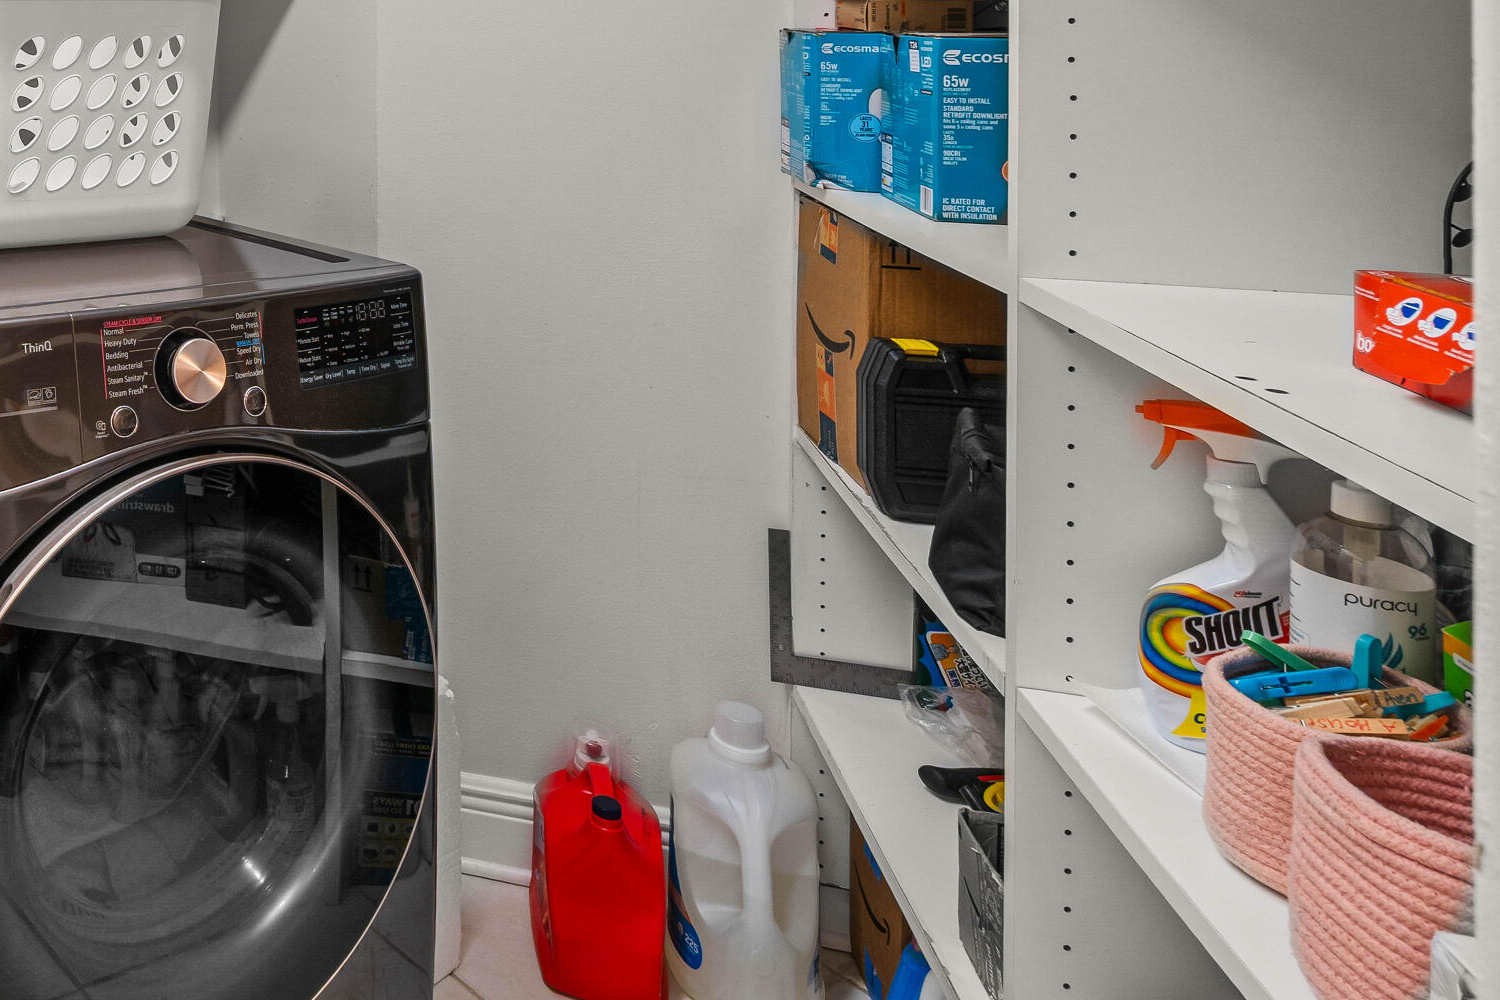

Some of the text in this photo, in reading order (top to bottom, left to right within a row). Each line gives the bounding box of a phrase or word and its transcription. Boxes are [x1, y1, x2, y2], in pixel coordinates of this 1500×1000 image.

[235, 311, 258, 320] Delicates
[103, 328, 124, 336] Normal
[230, 322, 259, 332] Perm. Press
[21, 340, 53, 354] ThinQ
[104, 337, 137, 348] Heavy Duty
[105, 351, 129, 360] Bedding
[236, 345, 261, 356] Speed Dry
[254, 357, 262, 365] Dry
[106, 361, 143, 373] Antibacterial
[235, 369, 264, 380] Downloaded
[107, 376, 124, 385] Steam
[108, 389, 127, 399] Steam
[1344, 592, 1418, 617] puracy
[1408, 623, 1428, 639] 96
